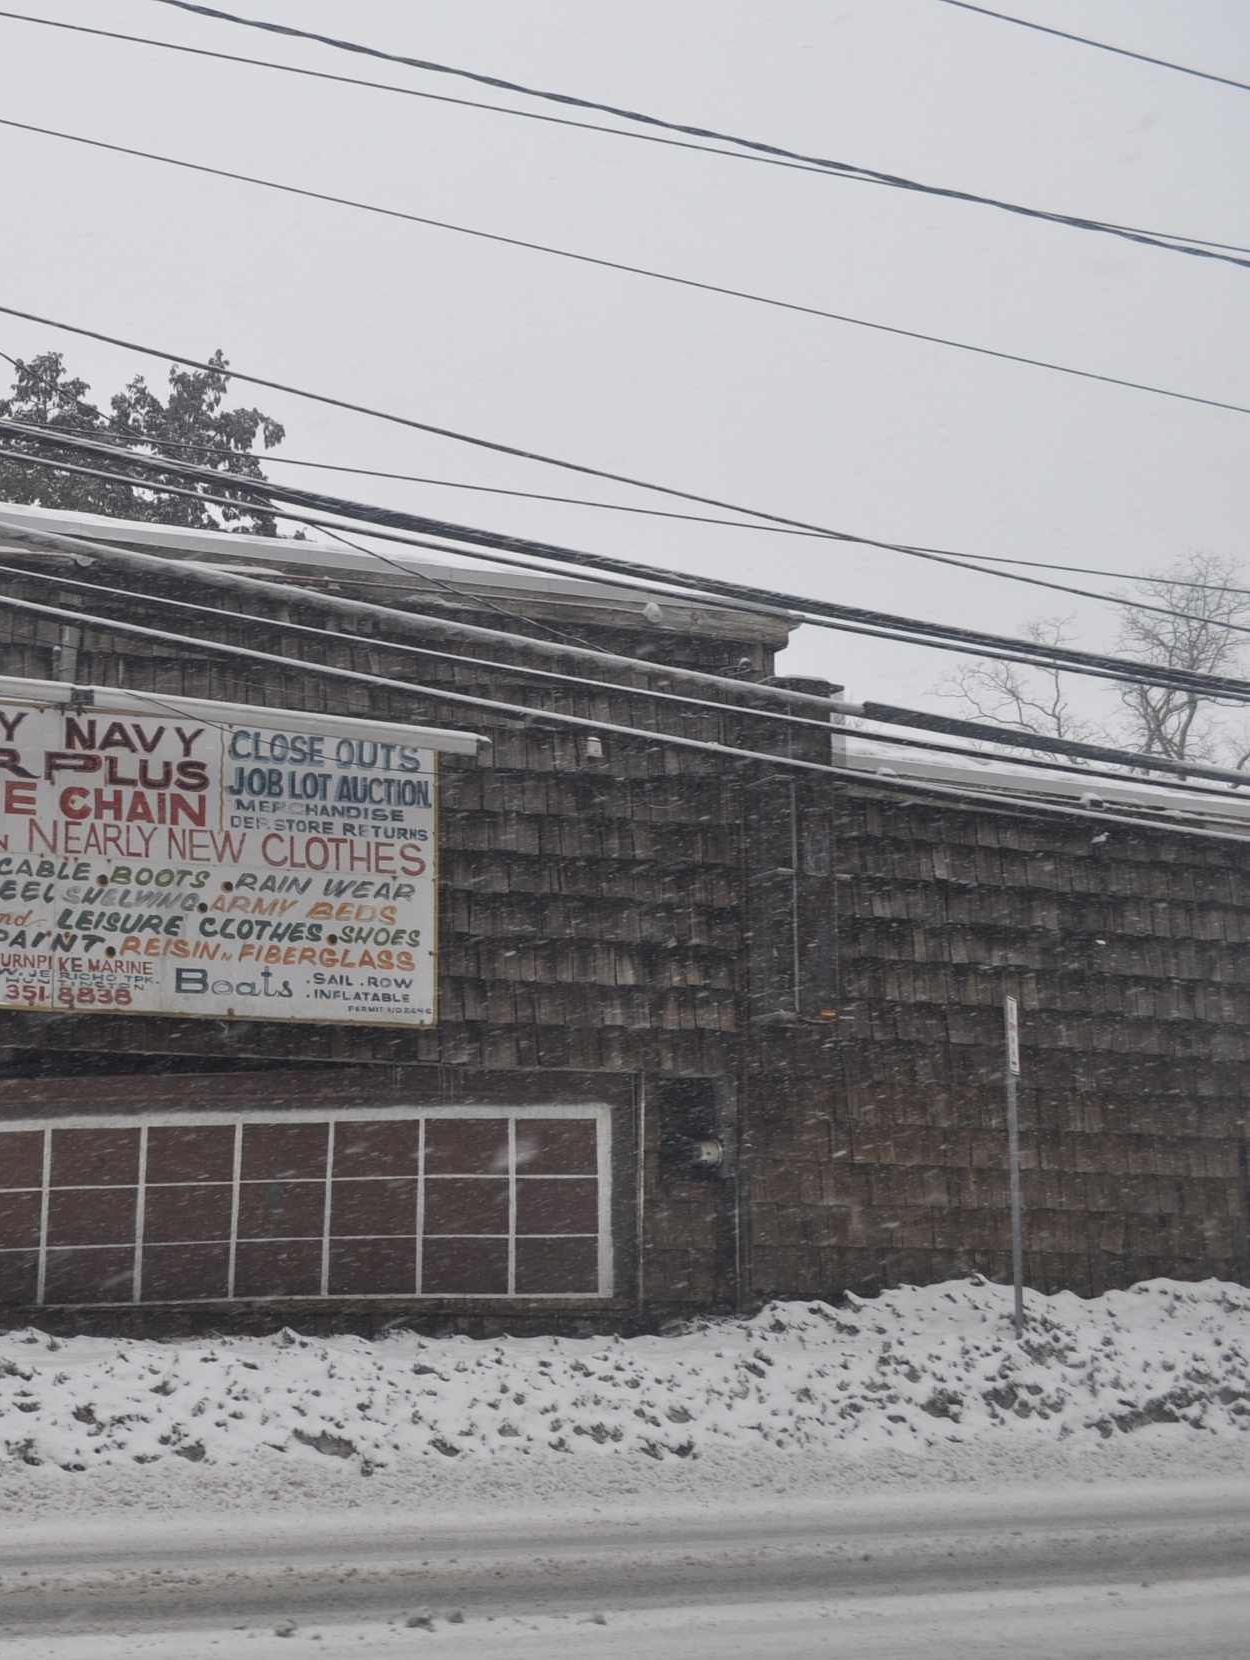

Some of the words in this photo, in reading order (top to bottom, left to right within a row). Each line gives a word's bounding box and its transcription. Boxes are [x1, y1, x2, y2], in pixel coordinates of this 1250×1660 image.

[64, 716, 205, 757] NAVY
[229, 730, 325, 767] CLOSE
[336, 739, 421, 772] OUTS
[225, 767, 284, 798] JOB
[288, 771, 332, 801] LOT
[59, 786, 207, 827] CHAIN
[236, 799, 404, 822] MERCHANDISE
[28, 818, 159, 859] NEARLY
[168, 829, 247, 864] NEW
[261, 832, 426, 877] CLOTHES
[274, 819, 334, 835] STORE
[342, 823, 429, 841] RETURNS
[109, 865, 211, 889] BOOTS
[235, 873, 312, 895] RAIN
[323, 879, 416, 901] WEAR
[62, 885, 200, 912] SHELVING
[209, 894, 300, 917] ARMY
[306, 901, 397, 925] BEDS
[57, 908, 184, 937] LEISURE
[199, 917, 323, 943] CLOTHES
[338, 925, 421, 948] SHOES
[88, 958, 153, 975] MARINE
[119, 935, 221, 961] REISIN
[238, 944, 416, 971] FIBERGLASS
[124, 975, 160, 985] TPK.
[175, 966, 293, 998] Boats
[314, 989, 410, 1003] INFLATABLE
[348, 1005, 383, 1014] PERMIT
